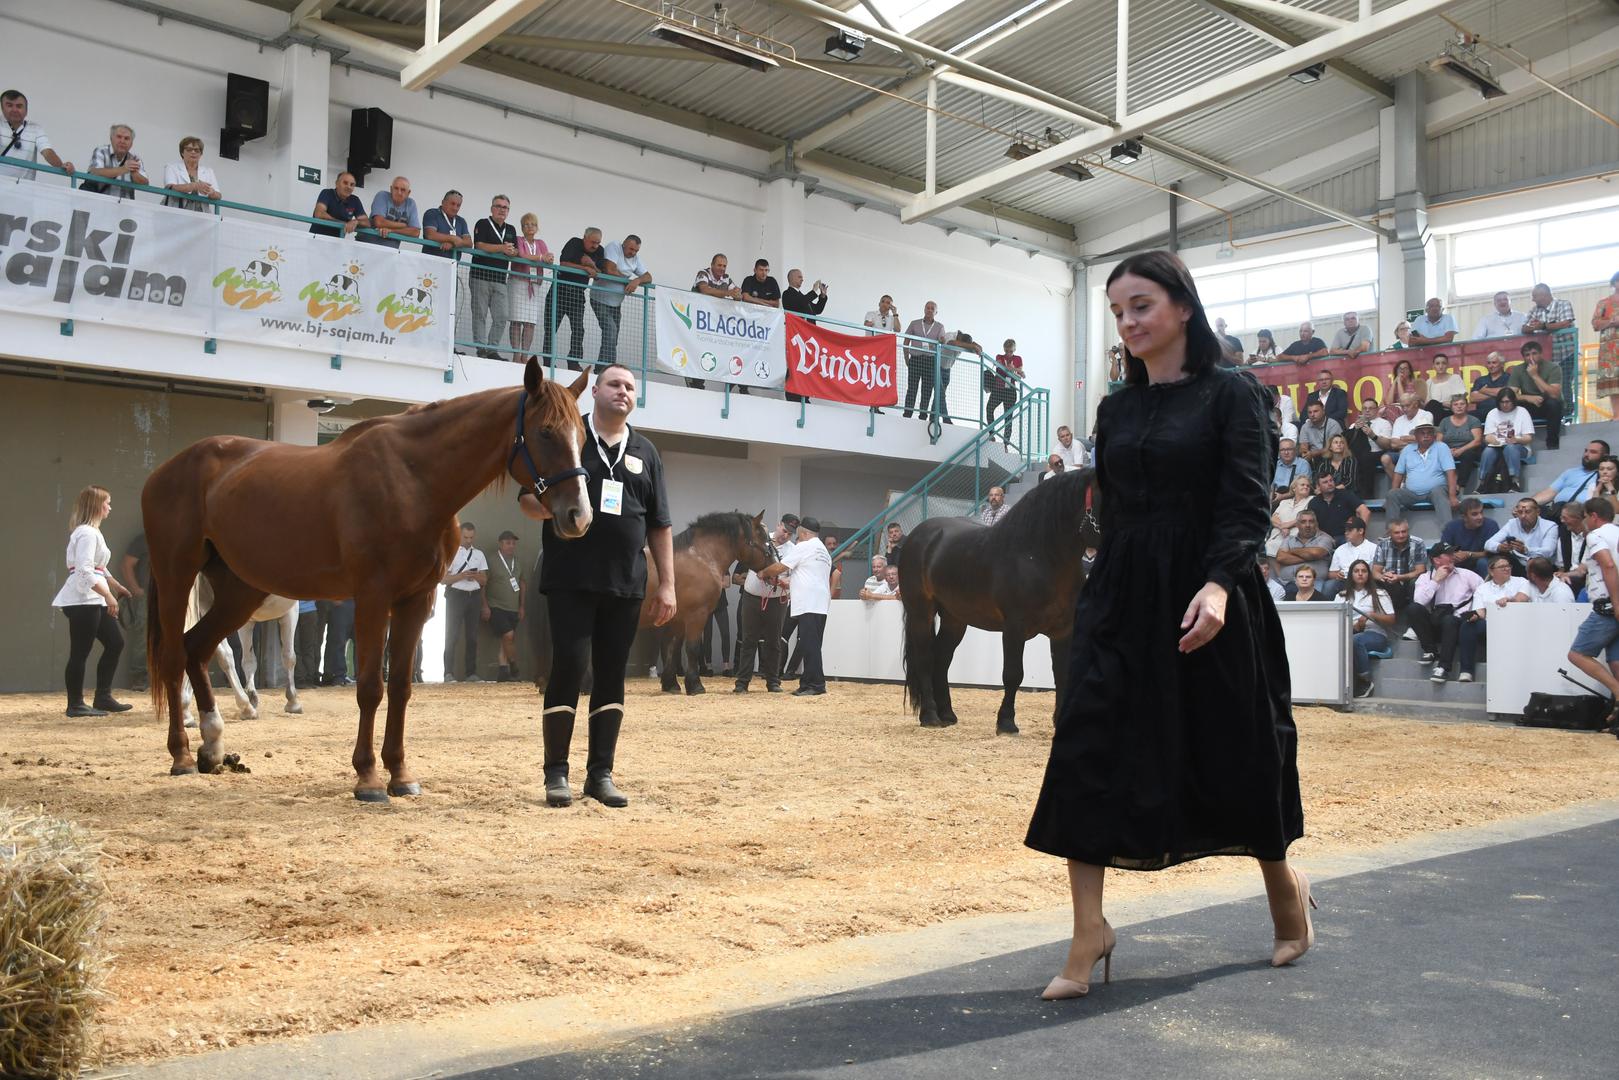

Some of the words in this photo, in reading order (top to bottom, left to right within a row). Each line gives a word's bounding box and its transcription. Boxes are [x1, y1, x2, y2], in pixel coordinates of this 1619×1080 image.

[0, 251, 187, 307] ajam
[260, 317, 396, 346] www.bj-sajam.hr
[697, 310, 771, 340] BLAGOdar
[791, 333, 892, 390] Vindija
